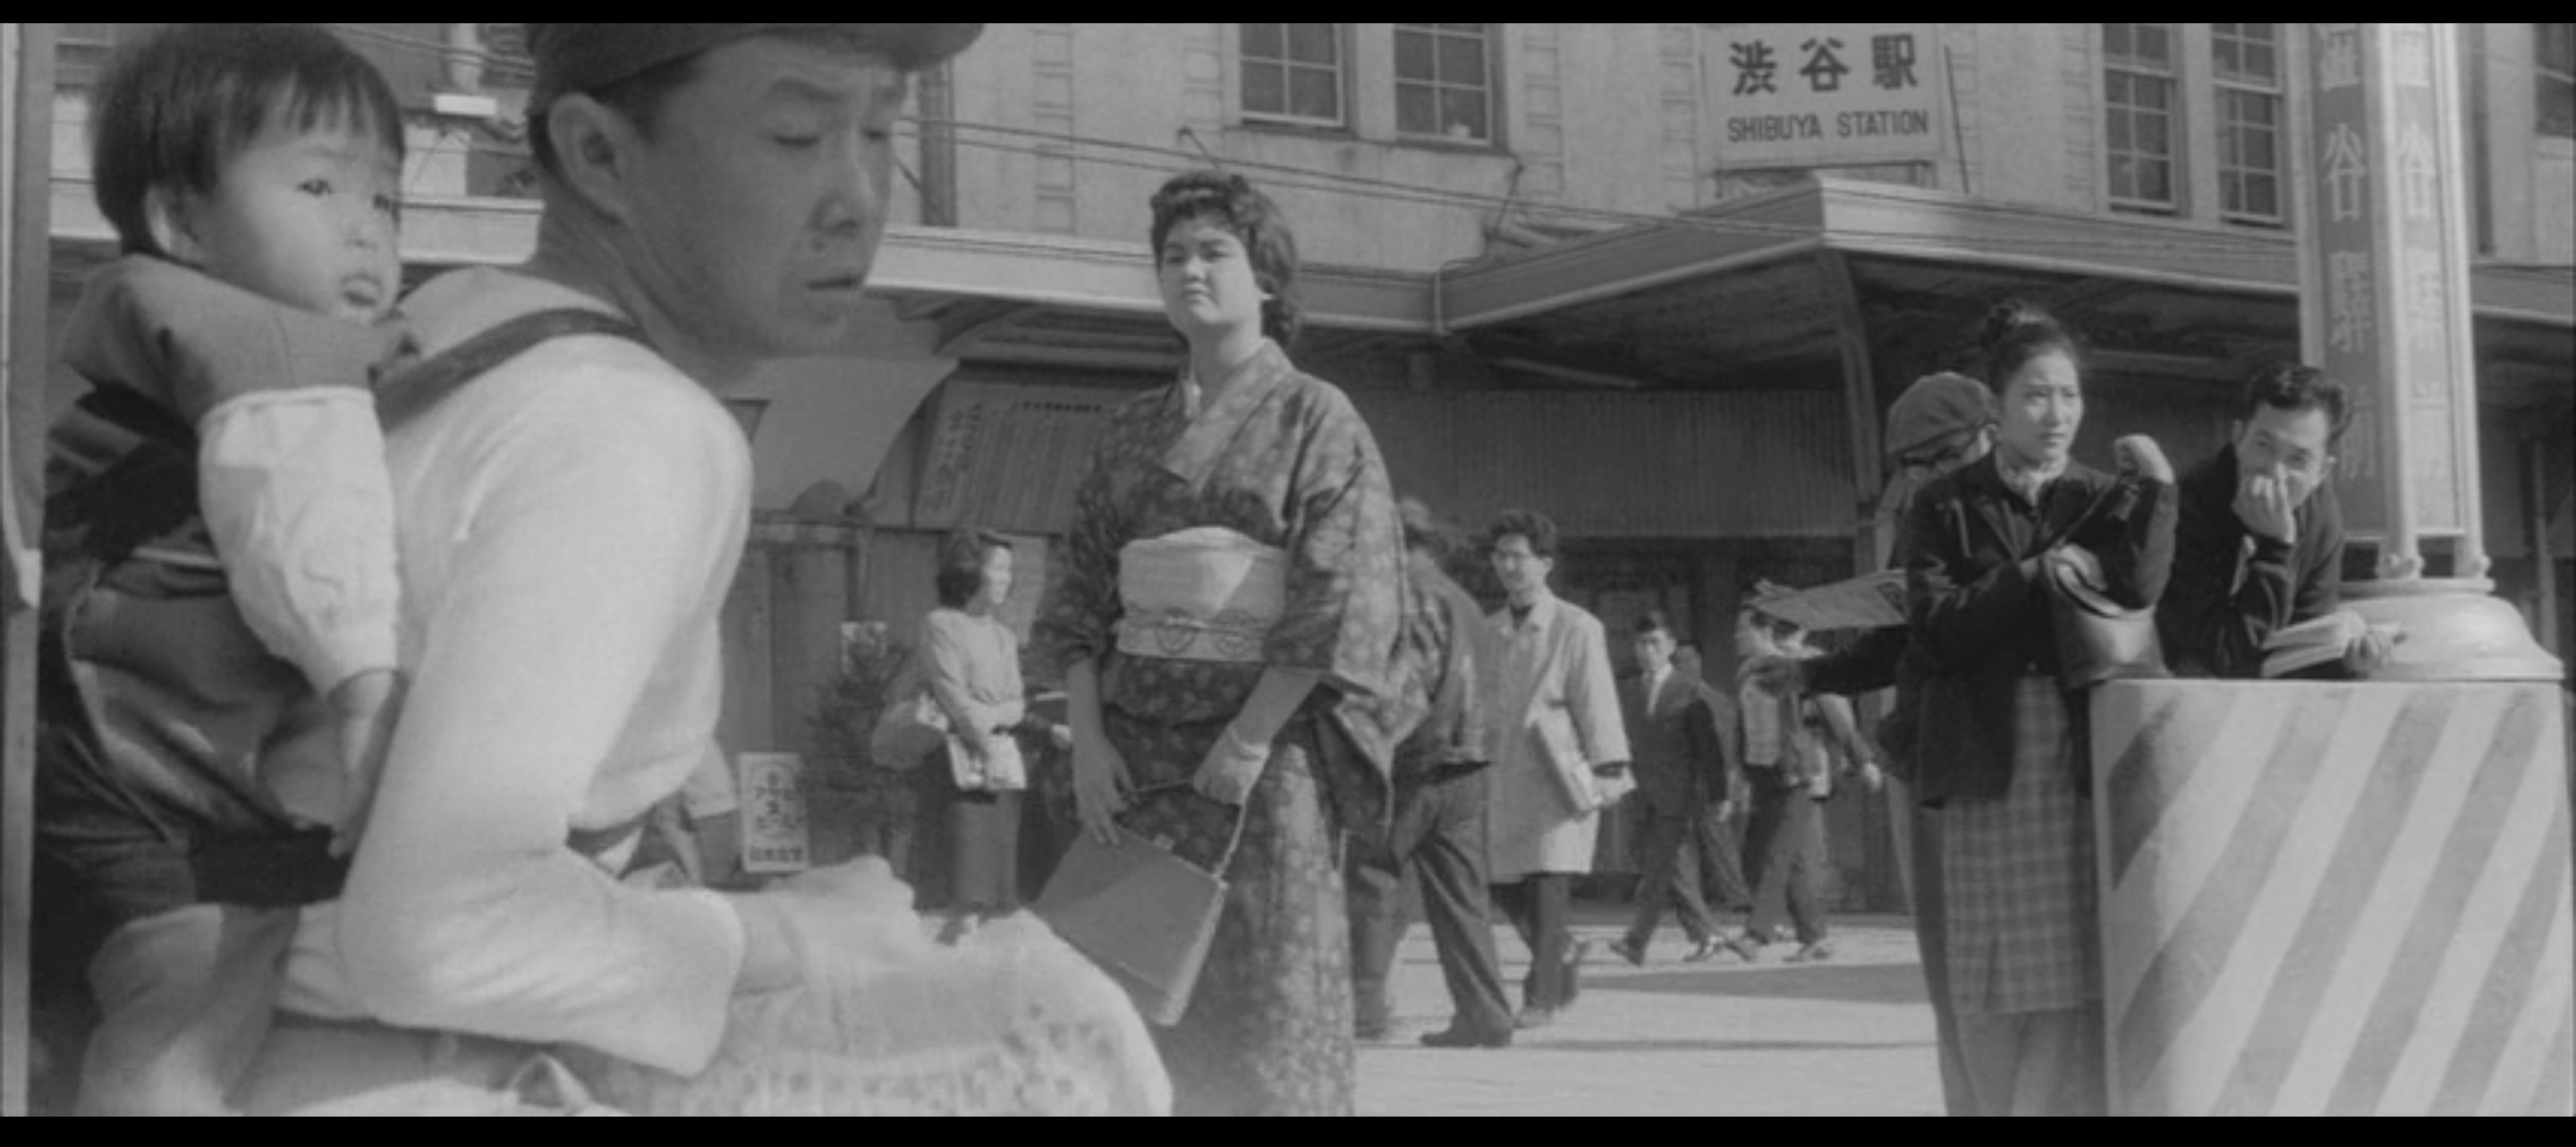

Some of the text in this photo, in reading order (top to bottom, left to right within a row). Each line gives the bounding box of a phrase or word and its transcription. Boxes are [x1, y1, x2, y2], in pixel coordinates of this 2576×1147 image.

[1729, 33, 1919, 96] 渋谷駅
[1727, 110, 1928, 143] SHIBUYA STATION
